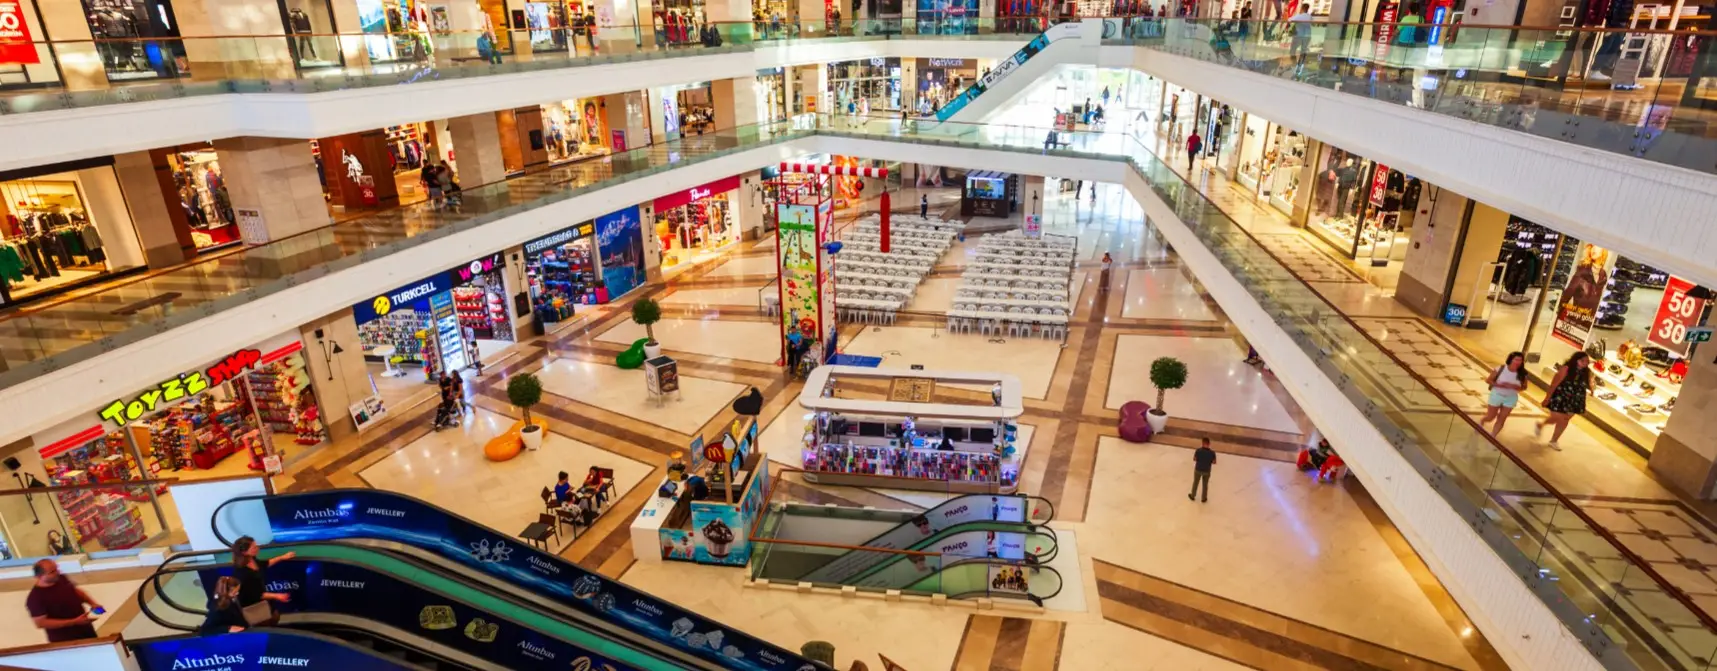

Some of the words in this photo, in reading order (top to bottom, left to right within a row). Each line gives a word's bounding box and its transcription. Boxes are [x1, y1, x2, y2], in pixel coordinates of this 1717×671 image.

[1377, 171, 1386, 184] 50
[391, 281, 437, 306] TURKCELL
[1668, 291, 1695, 318] 50
[1448, 307, 1465, 317] 300
[1658, 318, 1686, 345] 30
[366, 507, 406, 518] JEWELLERY
[320, 579, 365, 589] JEWELLERY
[257, 656, 310, 667] JEWELLERY
